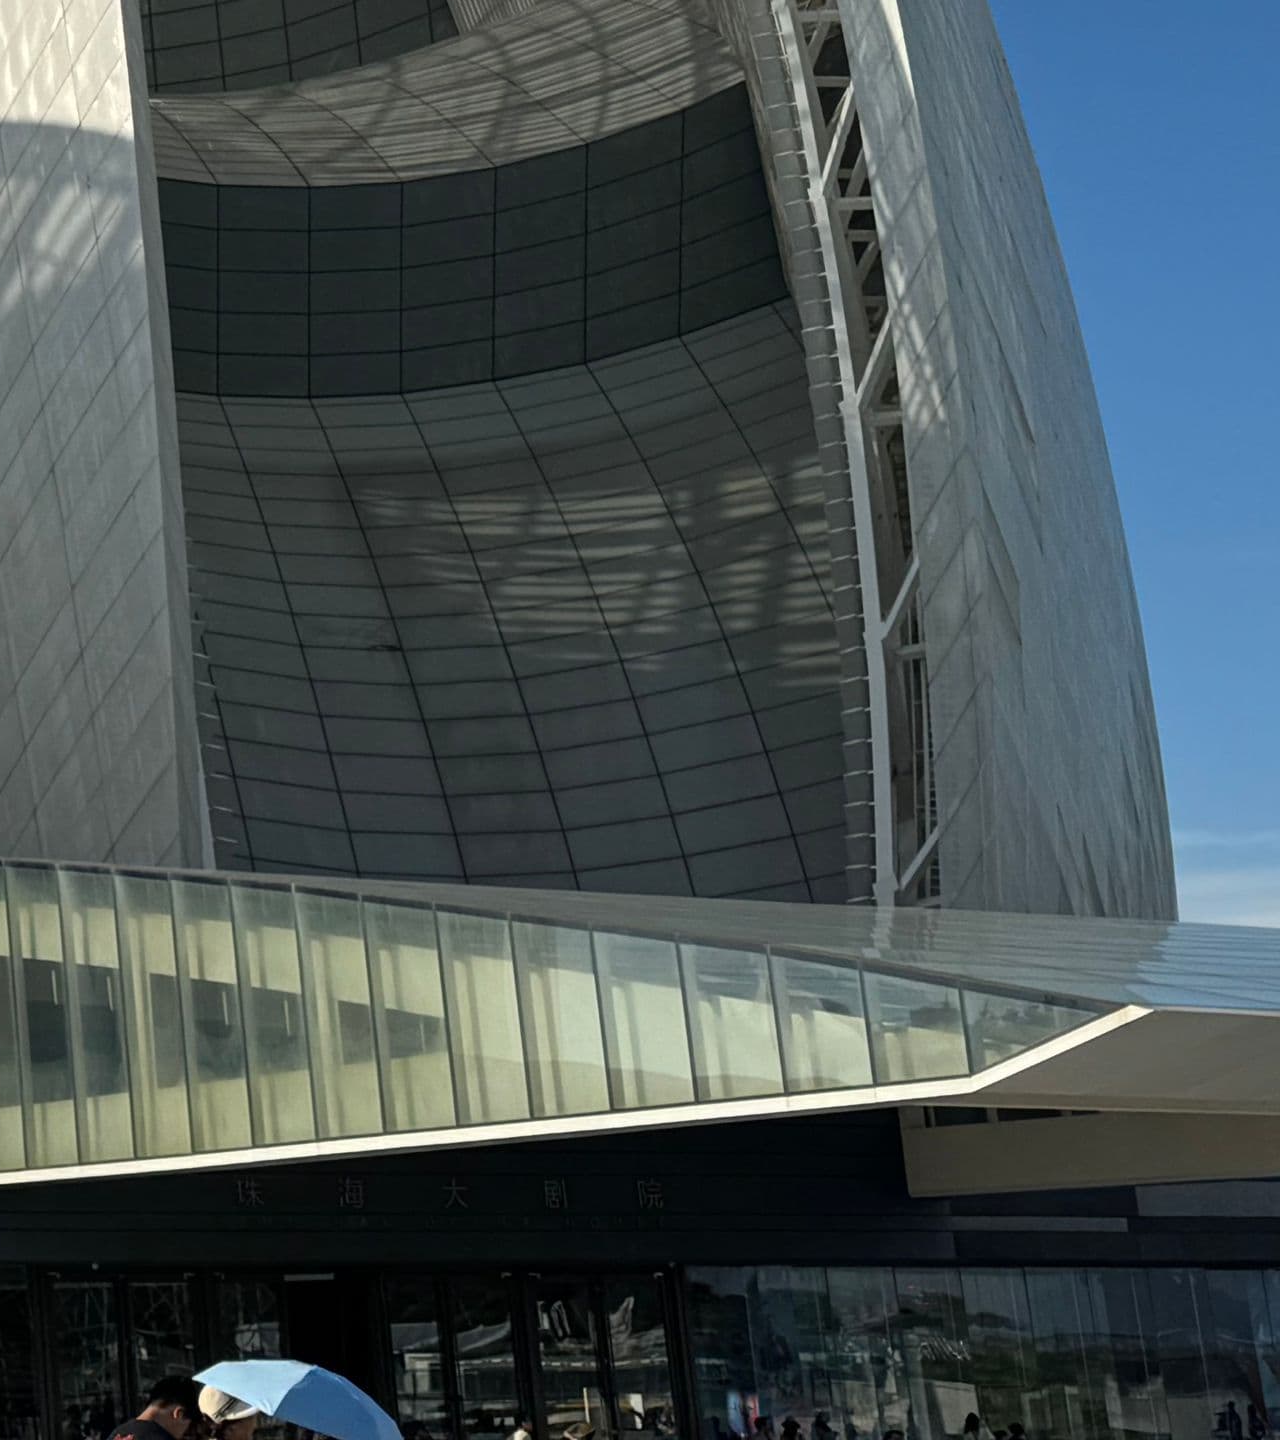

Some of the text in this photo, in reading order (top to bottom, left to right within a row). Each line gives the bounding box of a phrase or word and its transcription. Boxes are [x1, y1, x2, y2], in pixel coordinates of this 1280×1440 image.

[235, 1175, 665, 1209] 珠海大剧院
